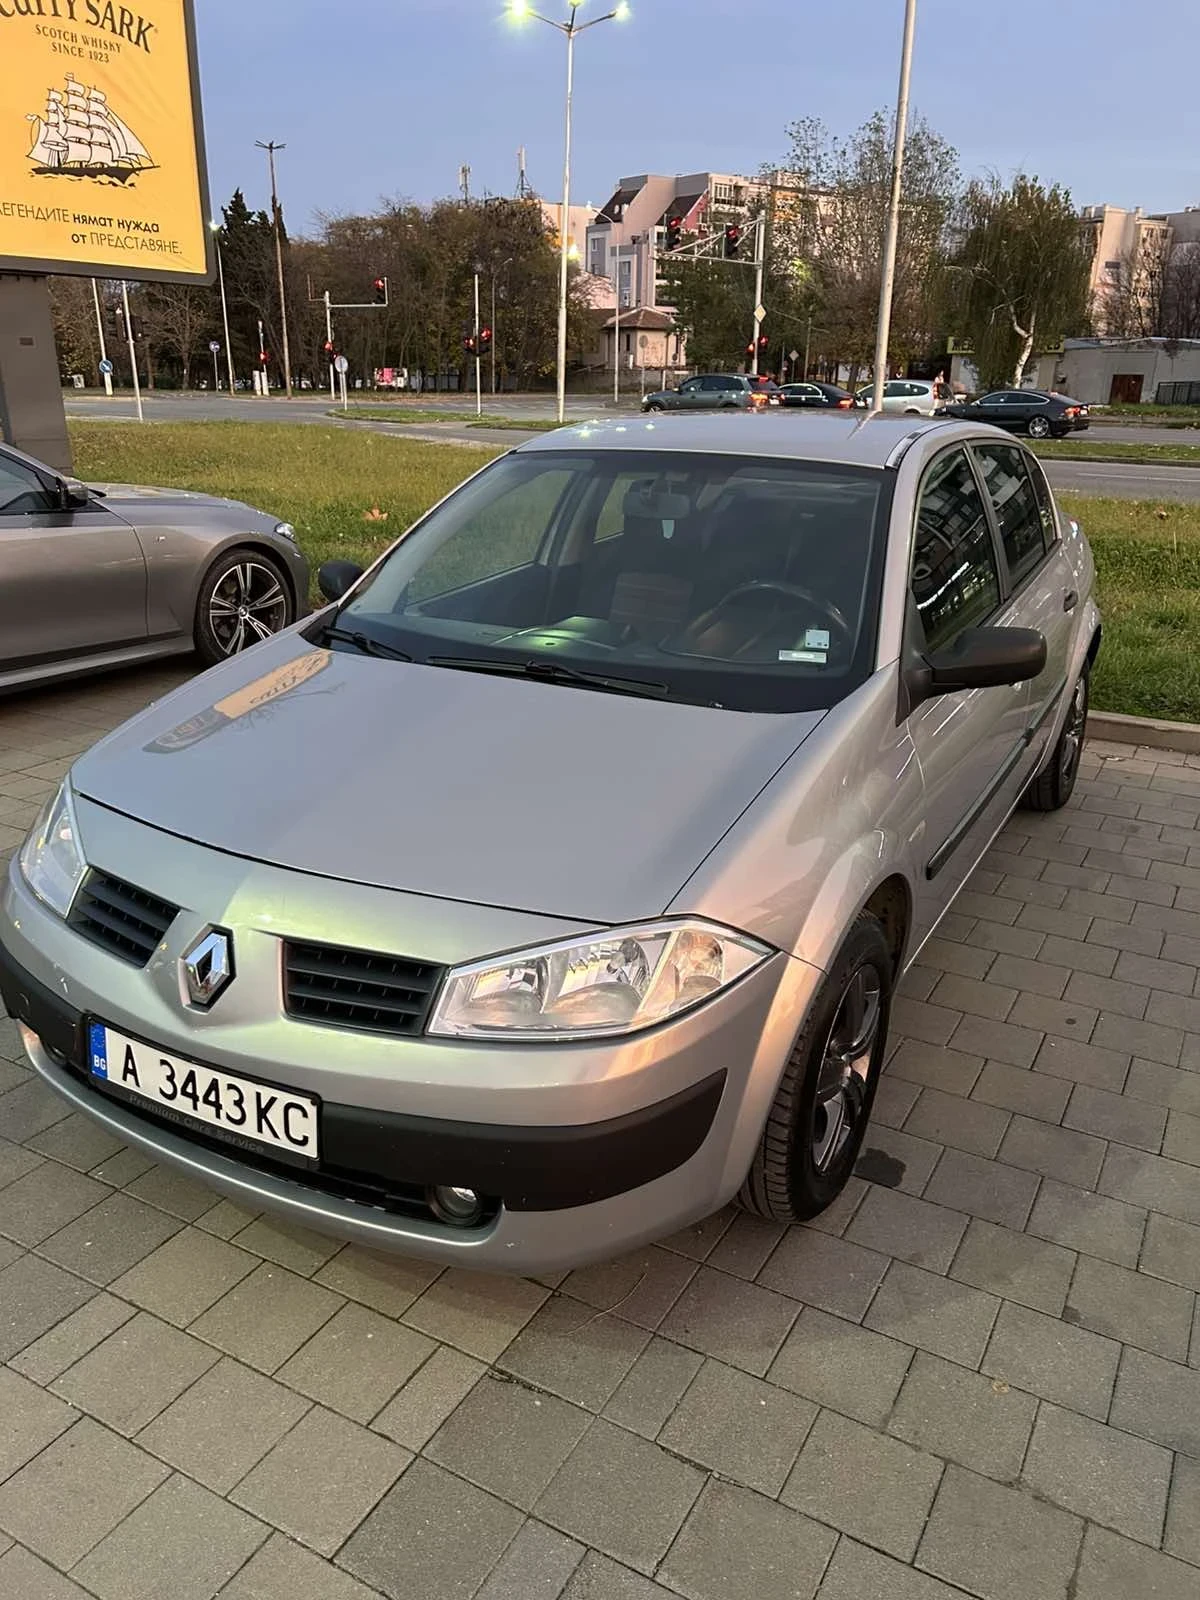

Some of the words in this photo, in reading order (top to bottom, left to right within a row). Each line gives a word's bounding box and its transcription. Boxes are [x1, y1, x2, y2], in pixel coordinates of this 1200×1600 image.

[85, 0, 154, 54] SARK
[35, 24, 78, 43] SCOTCH
[81, 35, 122, 53] WHISKY
[51, 42, 84, 58] SINCE
[88, 50, 110, 63] 1923
[72, 213, 114, 228] нямат
[117, 218, 160, 233] нужда
[71, 233, 87, 244] от
[90, 232, 183, 254] ПРЕДСТАВЯНЕ.
[93, 1054, 106, 1070] BG
[122, 1044, 140, 1088] A
